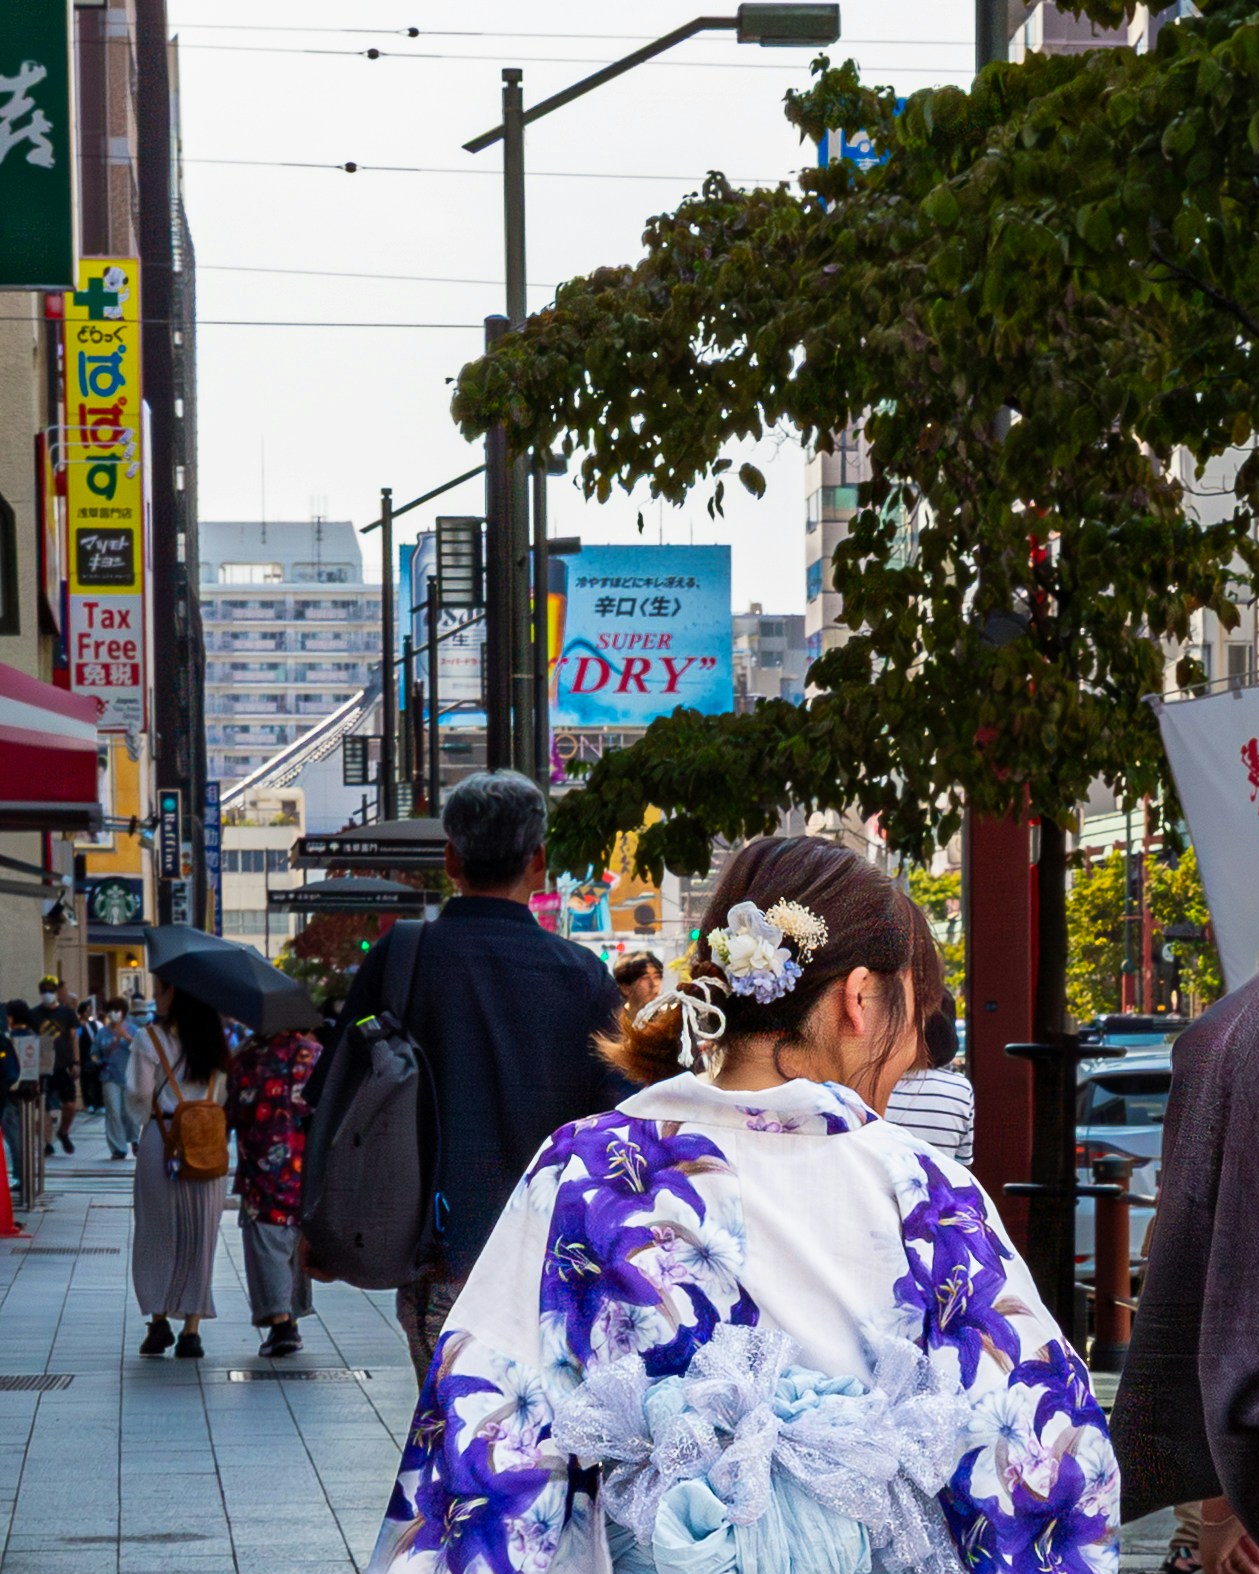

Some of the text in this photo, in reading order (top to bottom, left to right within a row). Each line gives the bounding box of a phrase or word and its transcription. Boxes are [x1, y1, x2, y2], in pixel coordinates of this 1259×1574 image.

[77, 344, 128, 501] ぱぱす
[83, 602, 131, 629] Tax
[78, 633, 137, 660] Free
[596, 632, 673, 650] SUPER
